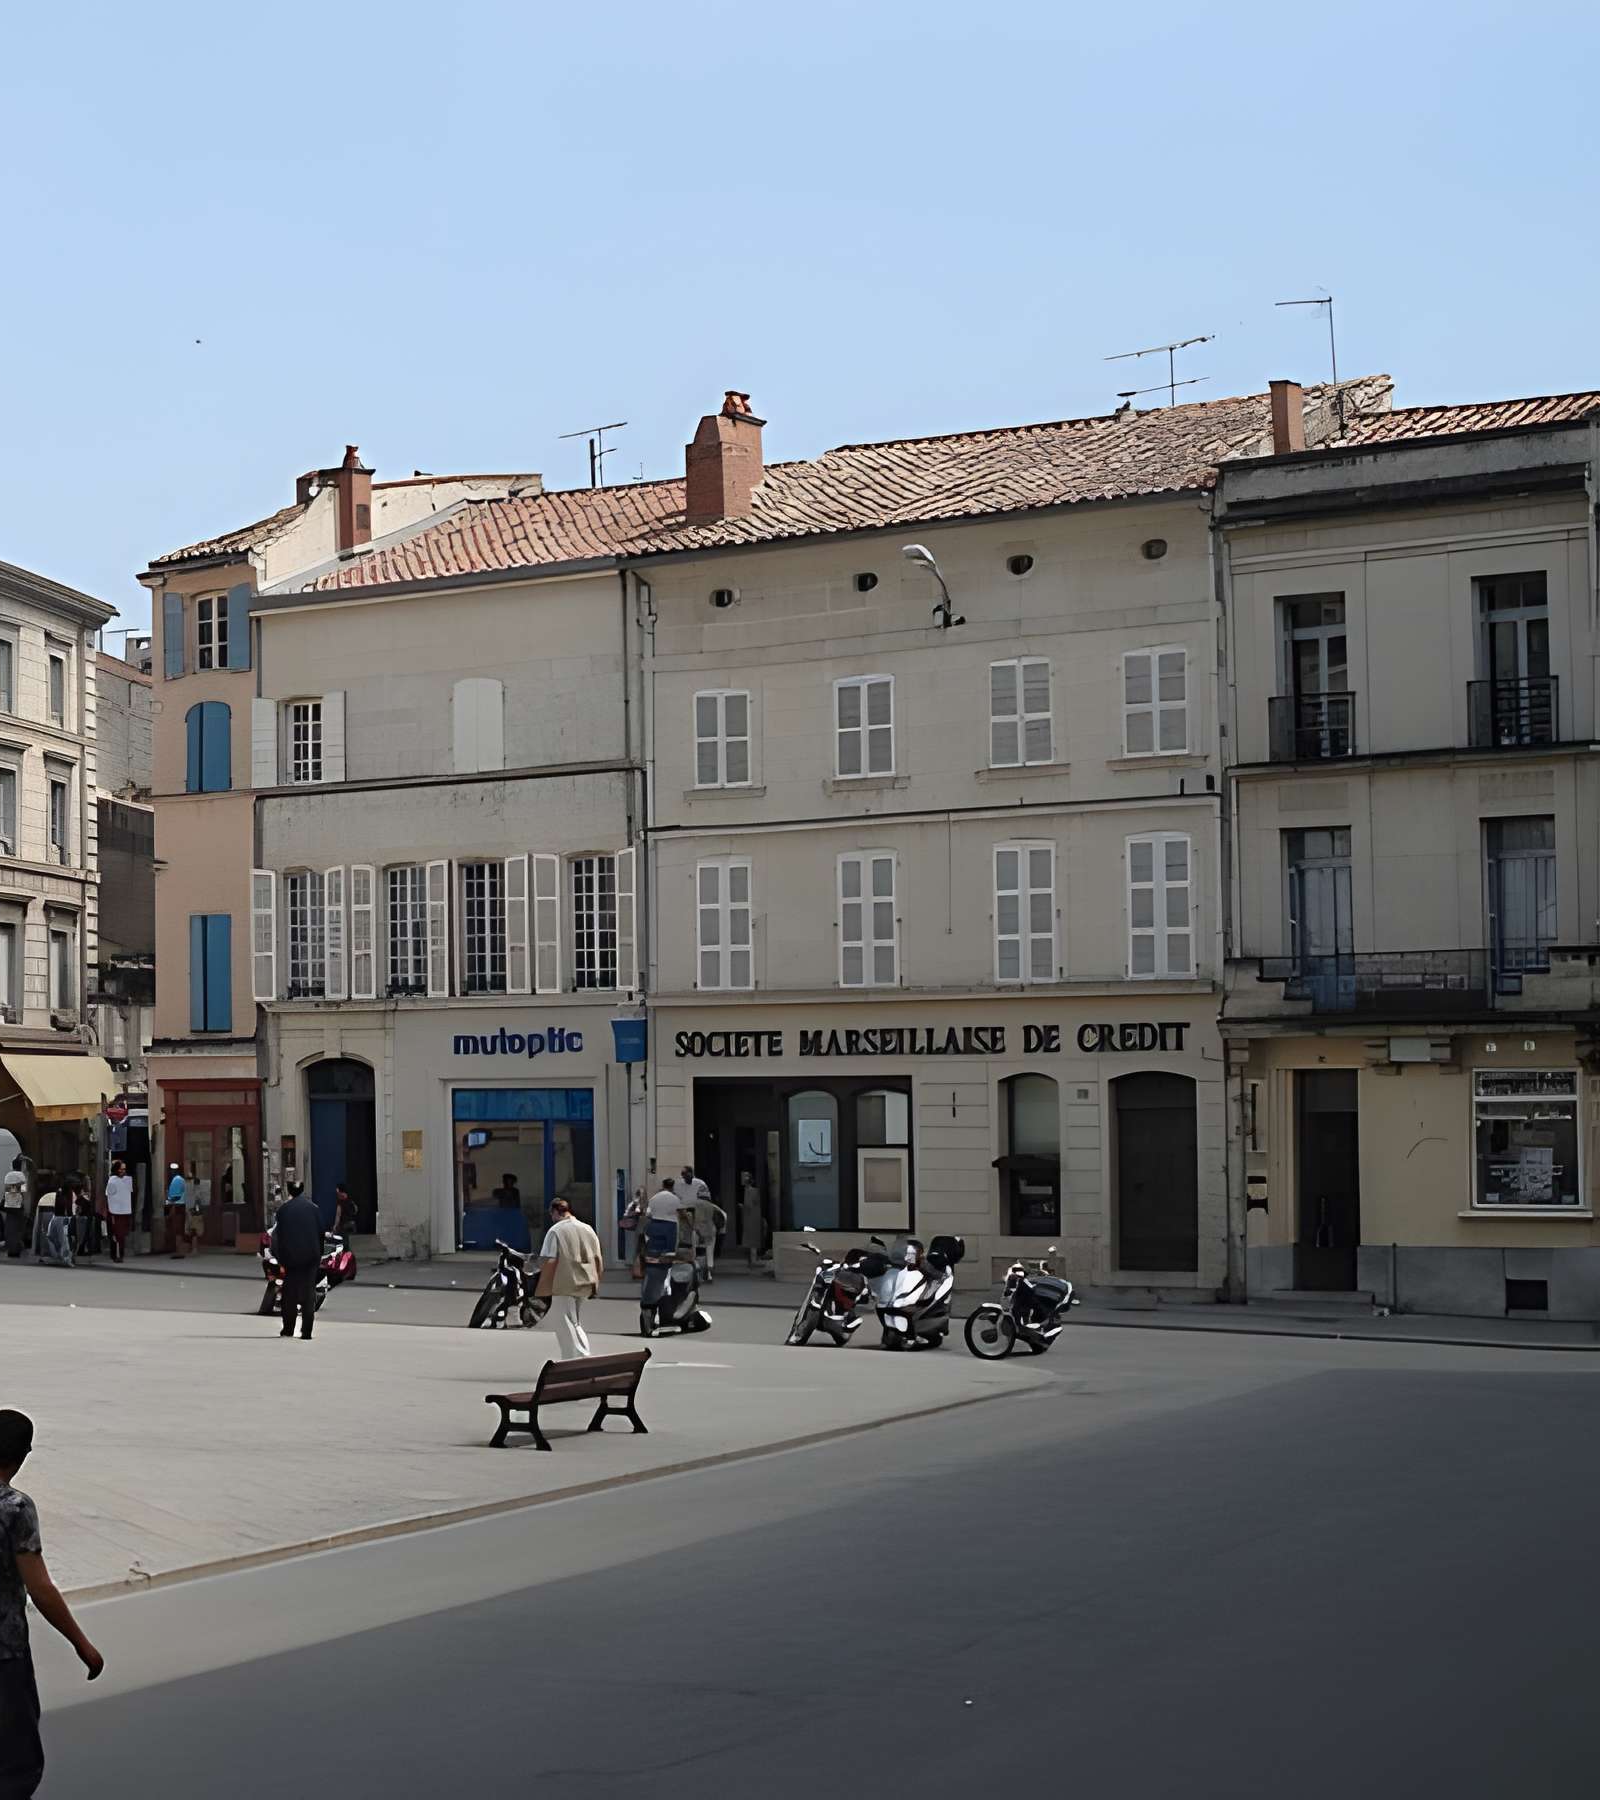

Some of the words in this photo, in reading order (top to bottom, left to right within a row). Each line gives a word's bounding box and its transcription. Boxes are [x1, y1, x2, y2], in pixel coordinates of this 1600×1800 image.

[675, 1030, 784, 1058] SOCIETE
[799, 1027, 1006, 1057] MARSEILLAISE
[1022, 1024, 1061, 1054] DE
[1077, 1022, 1191, 1053] CREDIT
